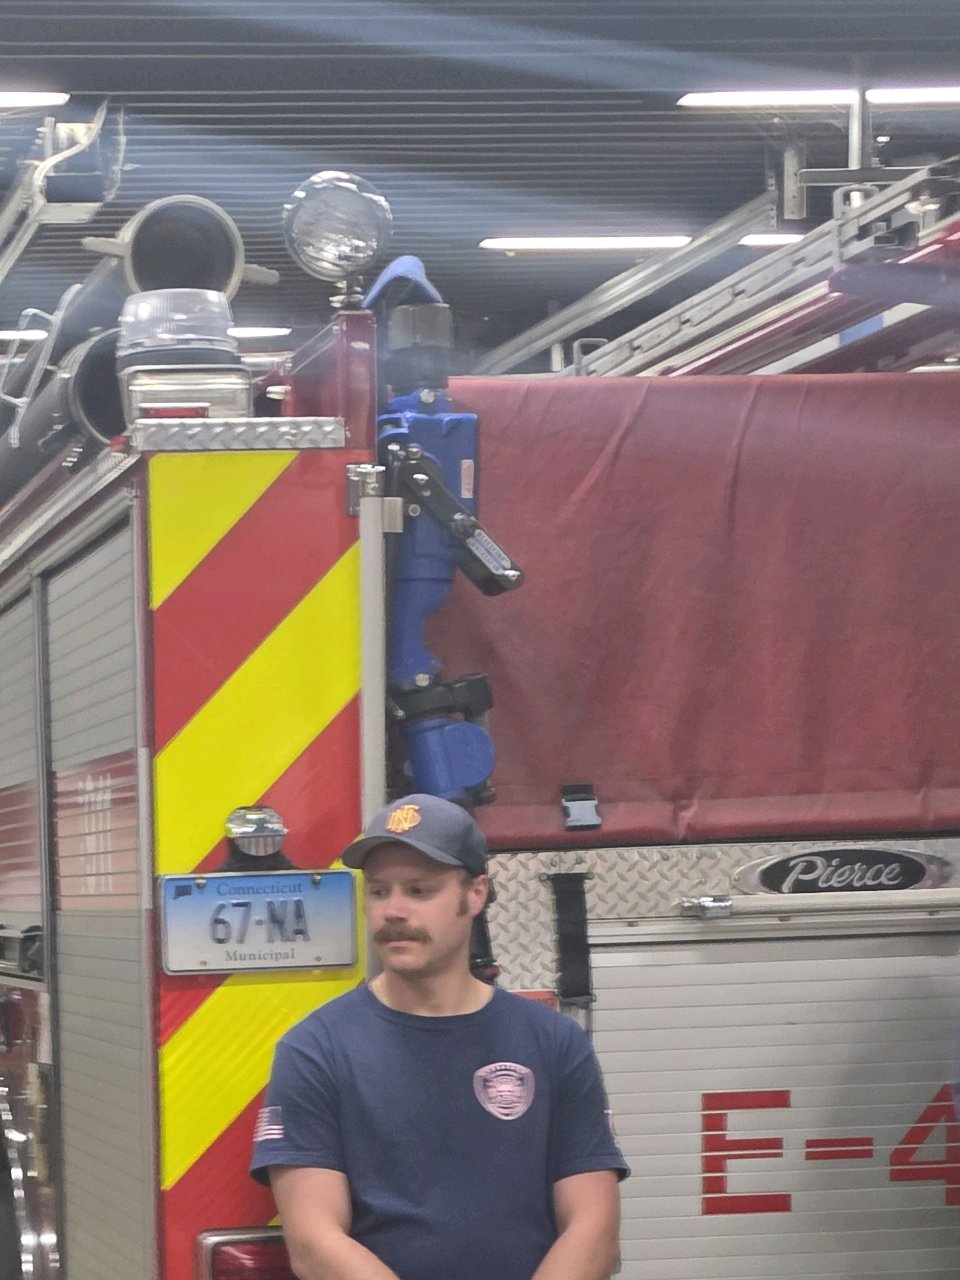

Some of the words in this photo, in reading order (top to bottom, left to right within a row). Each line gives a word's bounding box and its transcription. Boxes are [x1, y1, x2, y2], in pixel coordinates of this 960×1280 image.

[781, 855, 904, 893] Pierce
[216, 882, 304, 897] Connecticut
[208, 898, 311, 945] 67-NA
[225, 948, 296, 963] Municipal
